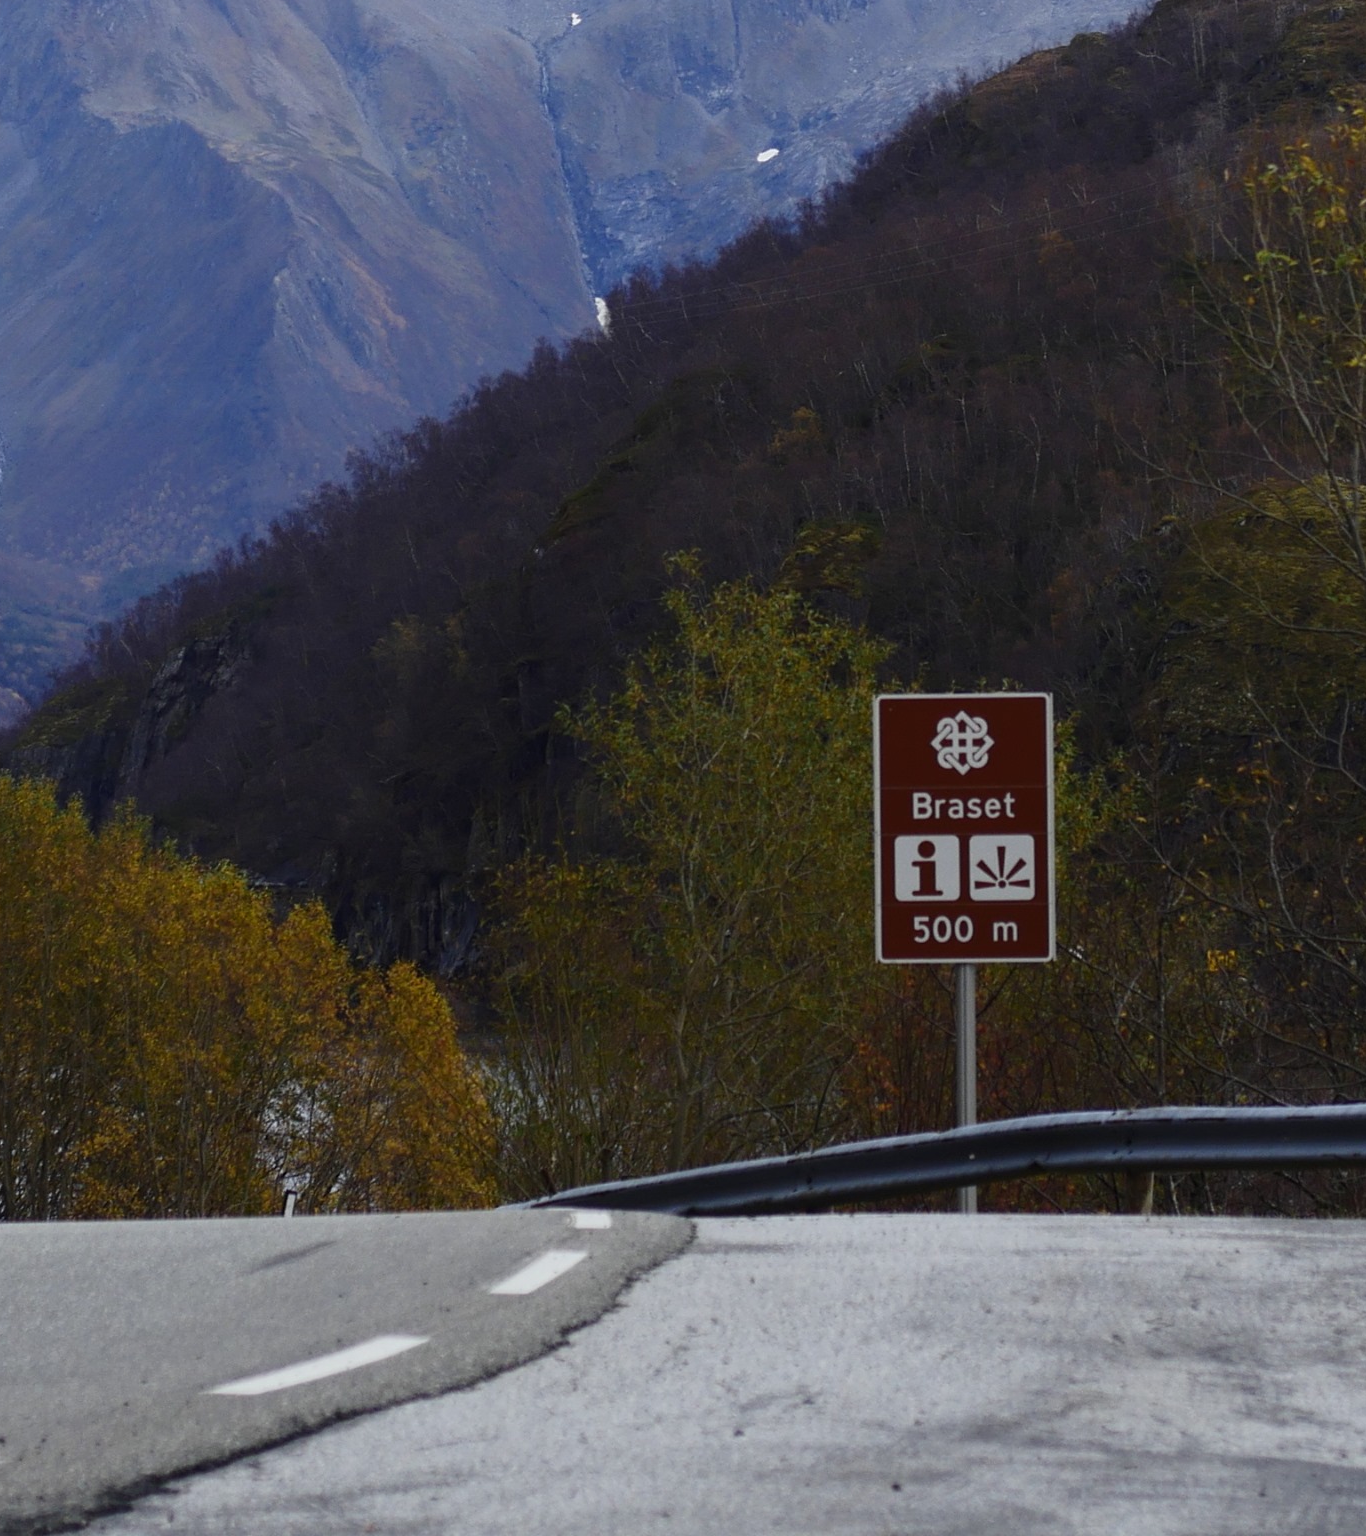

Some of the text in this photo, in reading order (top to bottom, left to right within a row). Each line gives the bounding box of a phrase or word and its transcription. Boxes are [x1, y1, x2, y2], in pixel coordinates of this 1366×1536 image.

[912, 792, 1015, 819] Braset
[913, 916, 1018, 943] 500 m
